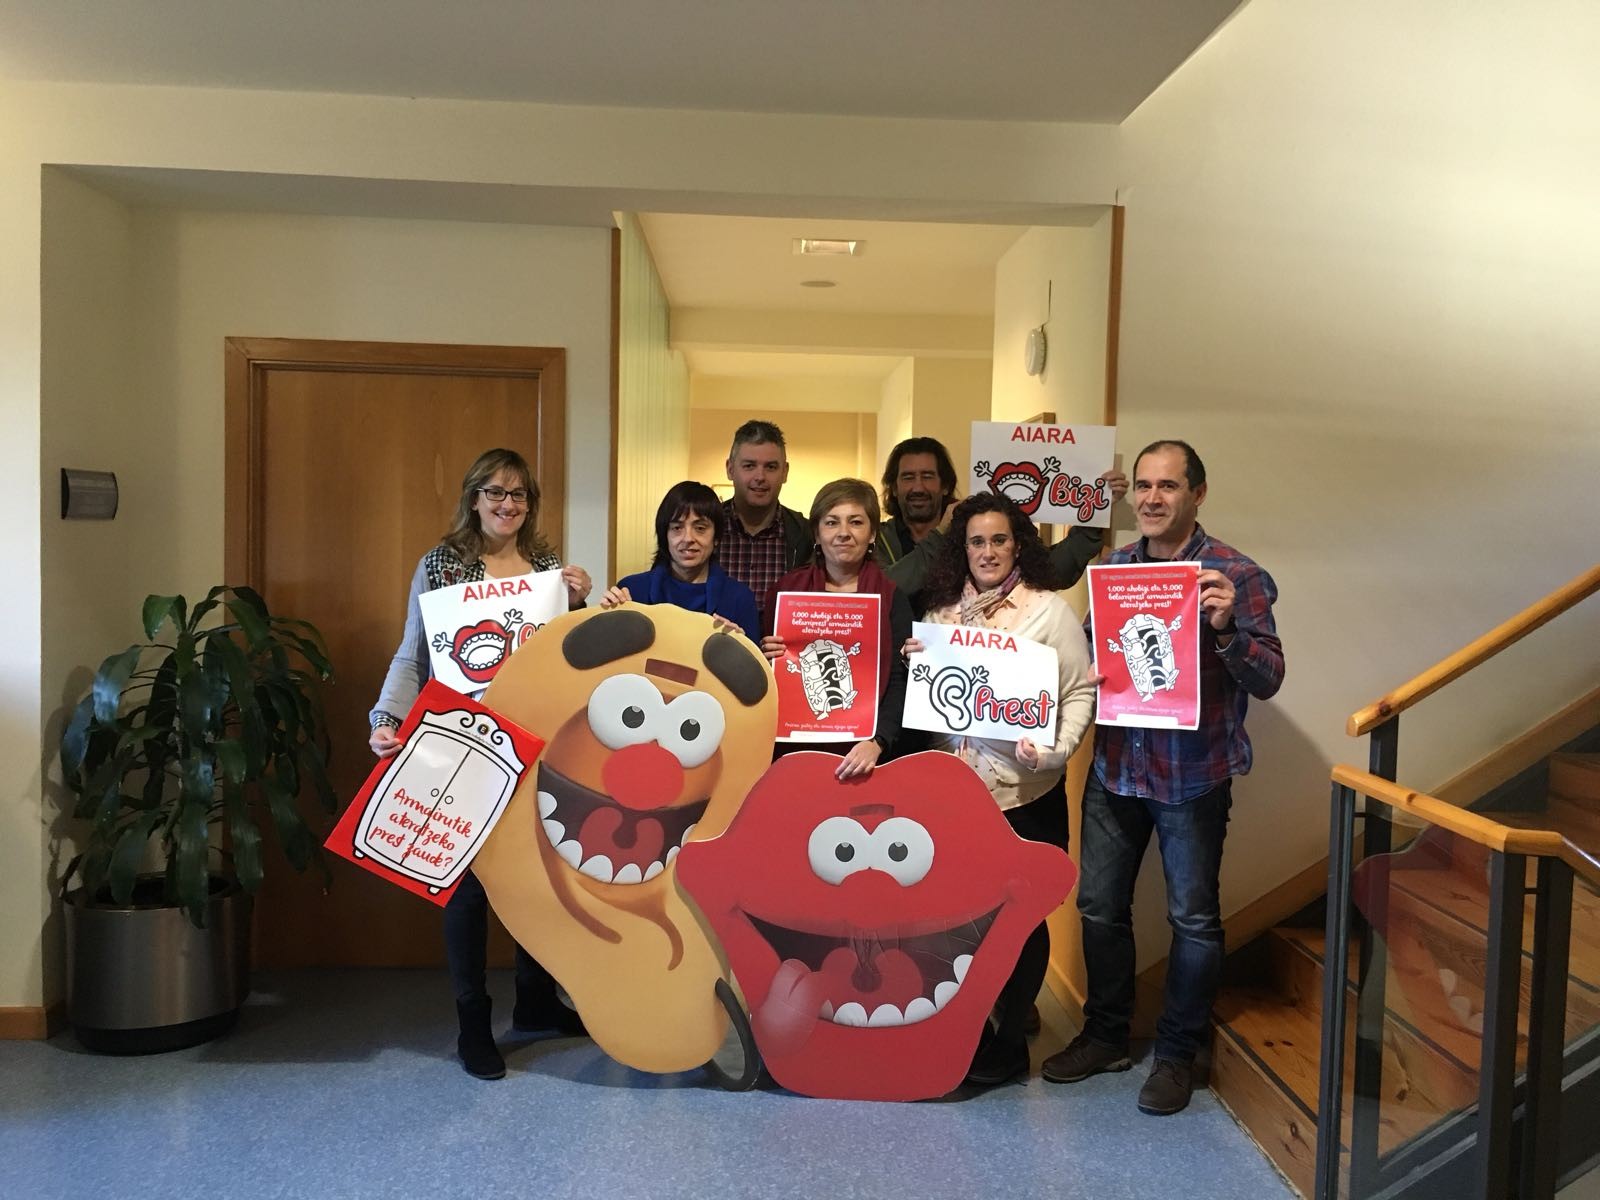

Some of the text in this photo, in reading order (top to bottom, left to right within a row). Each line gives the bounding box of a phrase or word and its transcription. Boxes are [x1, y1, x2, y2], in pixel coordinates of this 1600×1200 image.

[1011, 426, 1075, 444] AIARA
[463, 579, 532, 602] AIARA
[950, 629, 1018, 652] AIARA
[394, 788, 472, 838] Armairutik
[389, 812, 455, 851] ateratzeko
[369, 826, 454, 871] prest zaude?
